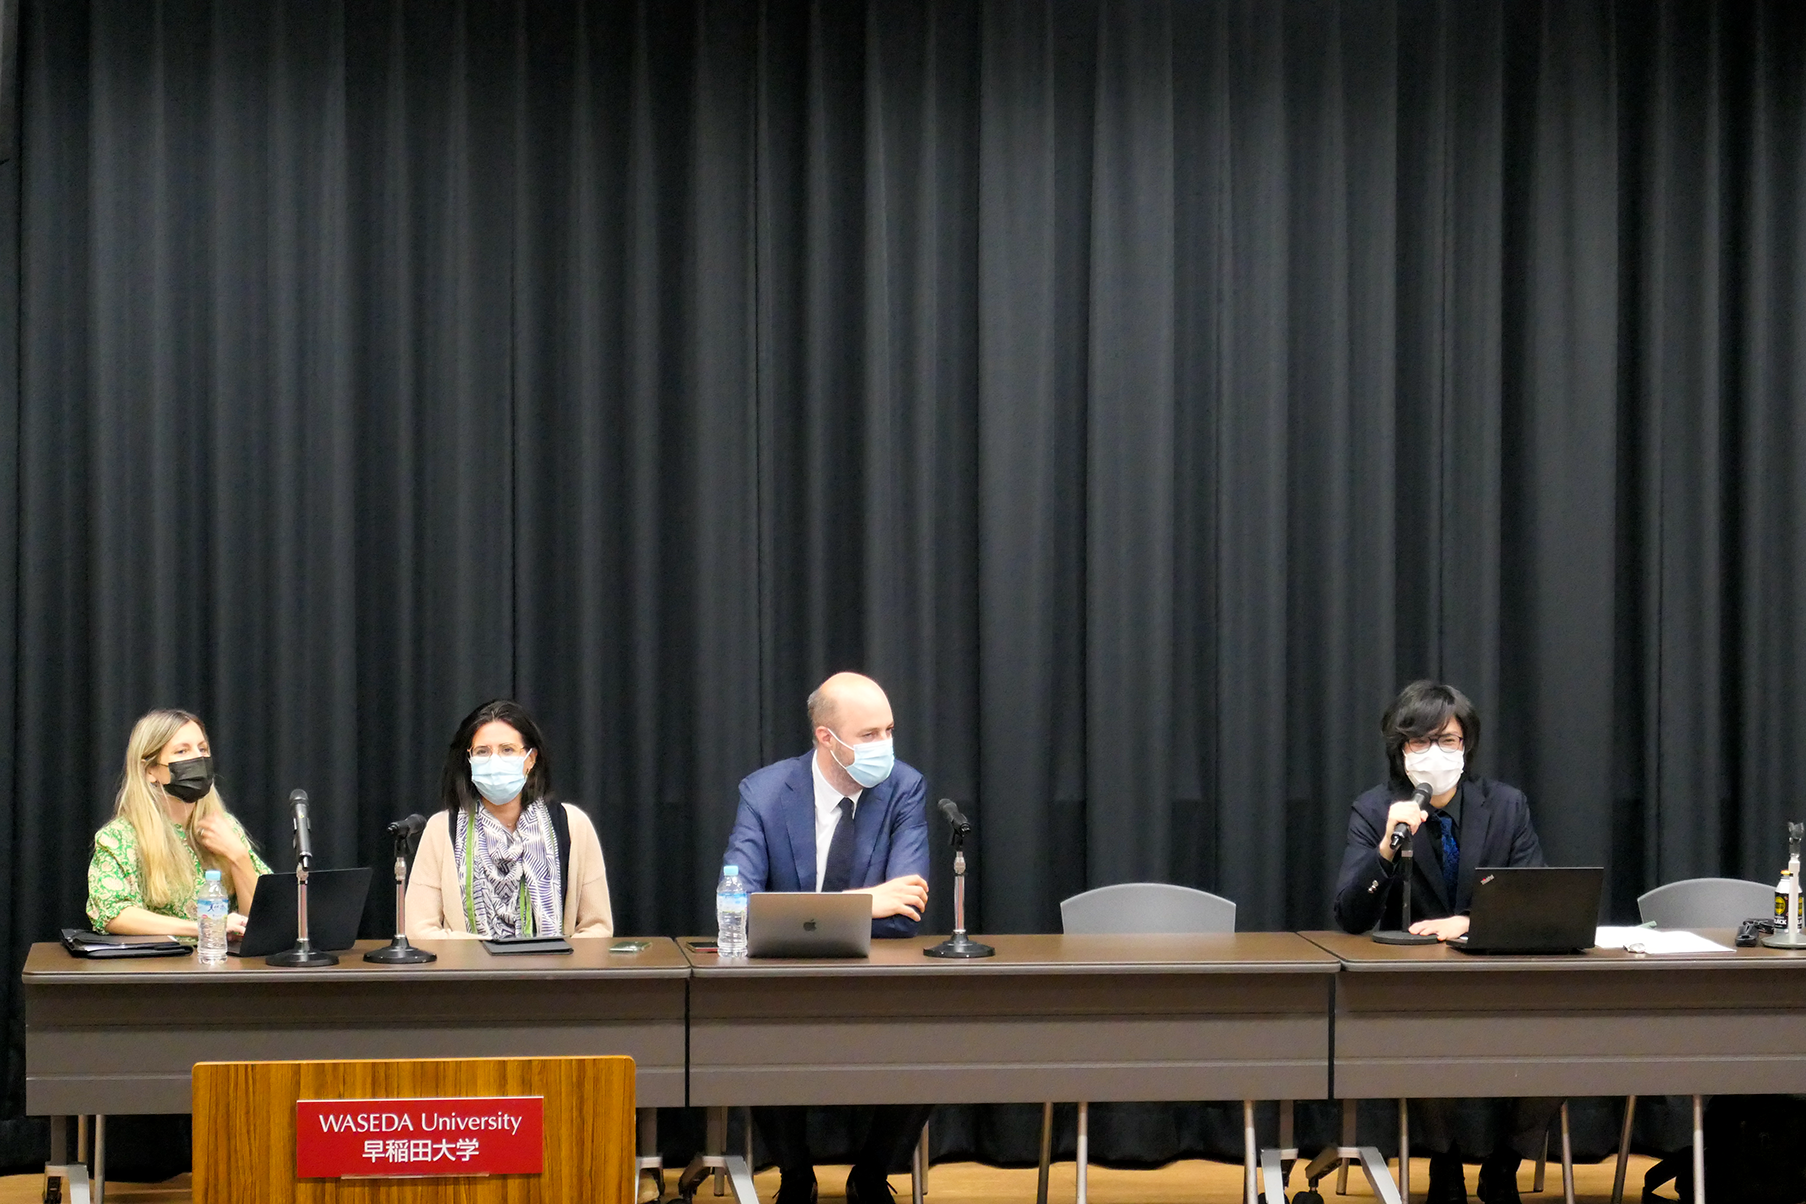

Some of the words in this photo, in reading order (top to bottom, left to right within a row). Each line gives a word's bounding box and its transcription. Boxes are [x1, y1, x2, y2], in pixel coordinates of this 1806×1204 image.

[319, 1112, 414, 1133] WASEDA
[422, 1111, 523, 1136] University
[362, 1138, 481, 1164] 早稲田大学
